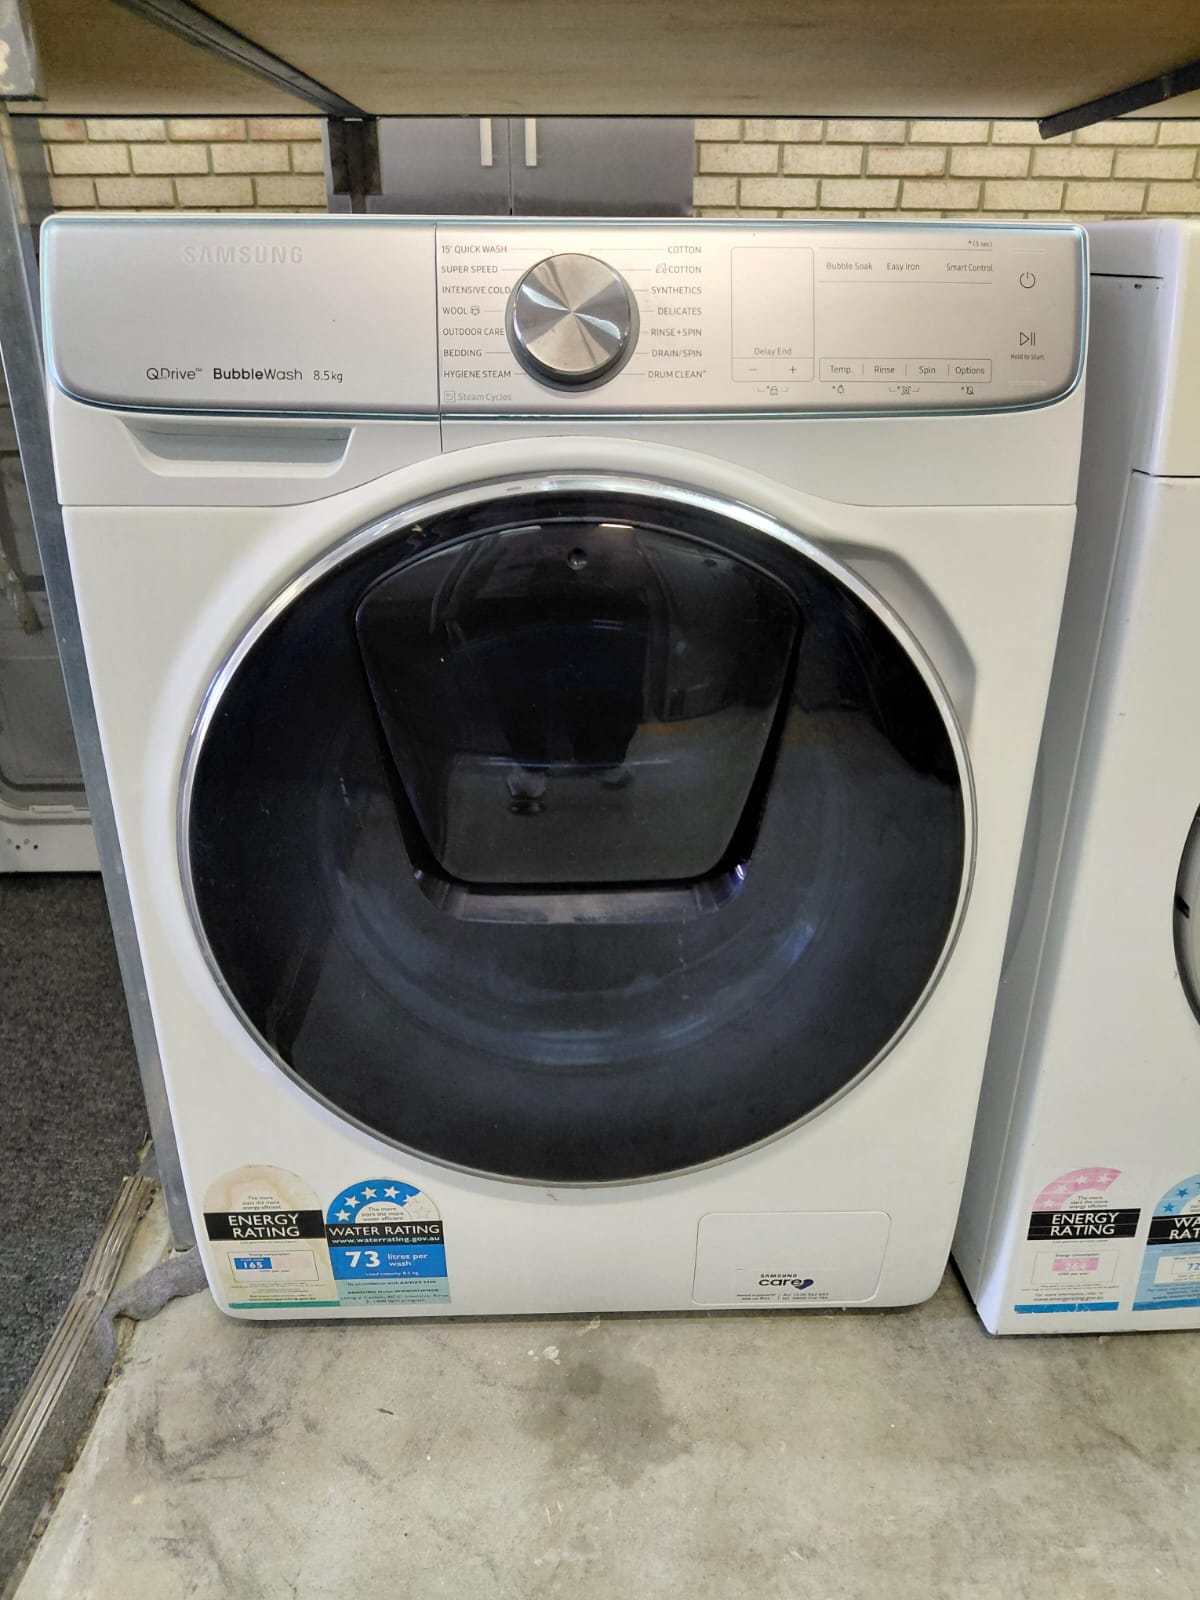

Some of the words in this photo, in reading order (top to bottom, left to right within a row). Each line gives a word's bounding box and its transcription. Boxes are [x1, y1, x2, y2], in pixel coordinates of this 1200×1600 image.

[454, 245, 480, 255] QUICK
[482, 245, 507, 254] WASH
[667, 246, 702, 254] COTTON
[184, 246, 303, 264] SAMSUNG
[441, 266, 468, 274] SUPER
[470, 266, 498, 274] SPEED
[668, 266, 702, 274] COTTON
[826, 262, 852, 271] Bubble
[855, 262, 872, 271] Soak
[886, 262, 904, 273] Easy
[904, 262, 920, 272] Iron
[946, 263, 966, 272] Smart
[968, 263, 993, 272] Control
[442, 286, 486, 294] INTENSIVE
[488, 286, 512, 294] COLD
[651, 286, 702, 294] SYNTHETICS
[442, 306, 468, 315] WOOL
[657, 307, 702, 316] DELICATES
[442, 328, 482, 336] OUTDOOR
[484, 328, 504, 336] CARE
[443, 349, 482, 357] BEDDING
[652, 349, 702, 358] DRAIN/SPIN
[754, 347, 776, 356] Delay
[777, 347, 792, 356] End
[213, 367, 303, 381] BubbleWash
[444, 370, 480, 378] HYGIENE
[482, 370, 512, 378] STEAM
[648, 370, 674, 378] DRUM
[830, 365, 851, 375] Temp
[874, 364, 896, 375] Rinse
[919, 365, 936, 376] Spin
[955, 365, 985, 376] Options
[458, 392, 484, 401] Steam
[486, 392, 512, 402] Cycles
[228, 1213, 299, 1226] ENERGY
[1052, 1212, 1120, 1225] ENERGY
[232, 1226, 300, 1238] RATING
[329, 1227, 380, 1236] WATER
[384, 1224, 440, 1236] RATING
[1050, 1224, 1116, 1236] RATING
[332, 1236, 440, 1244] www.waterrating.gov.au
[345, 1250, 380, 1268] 73
